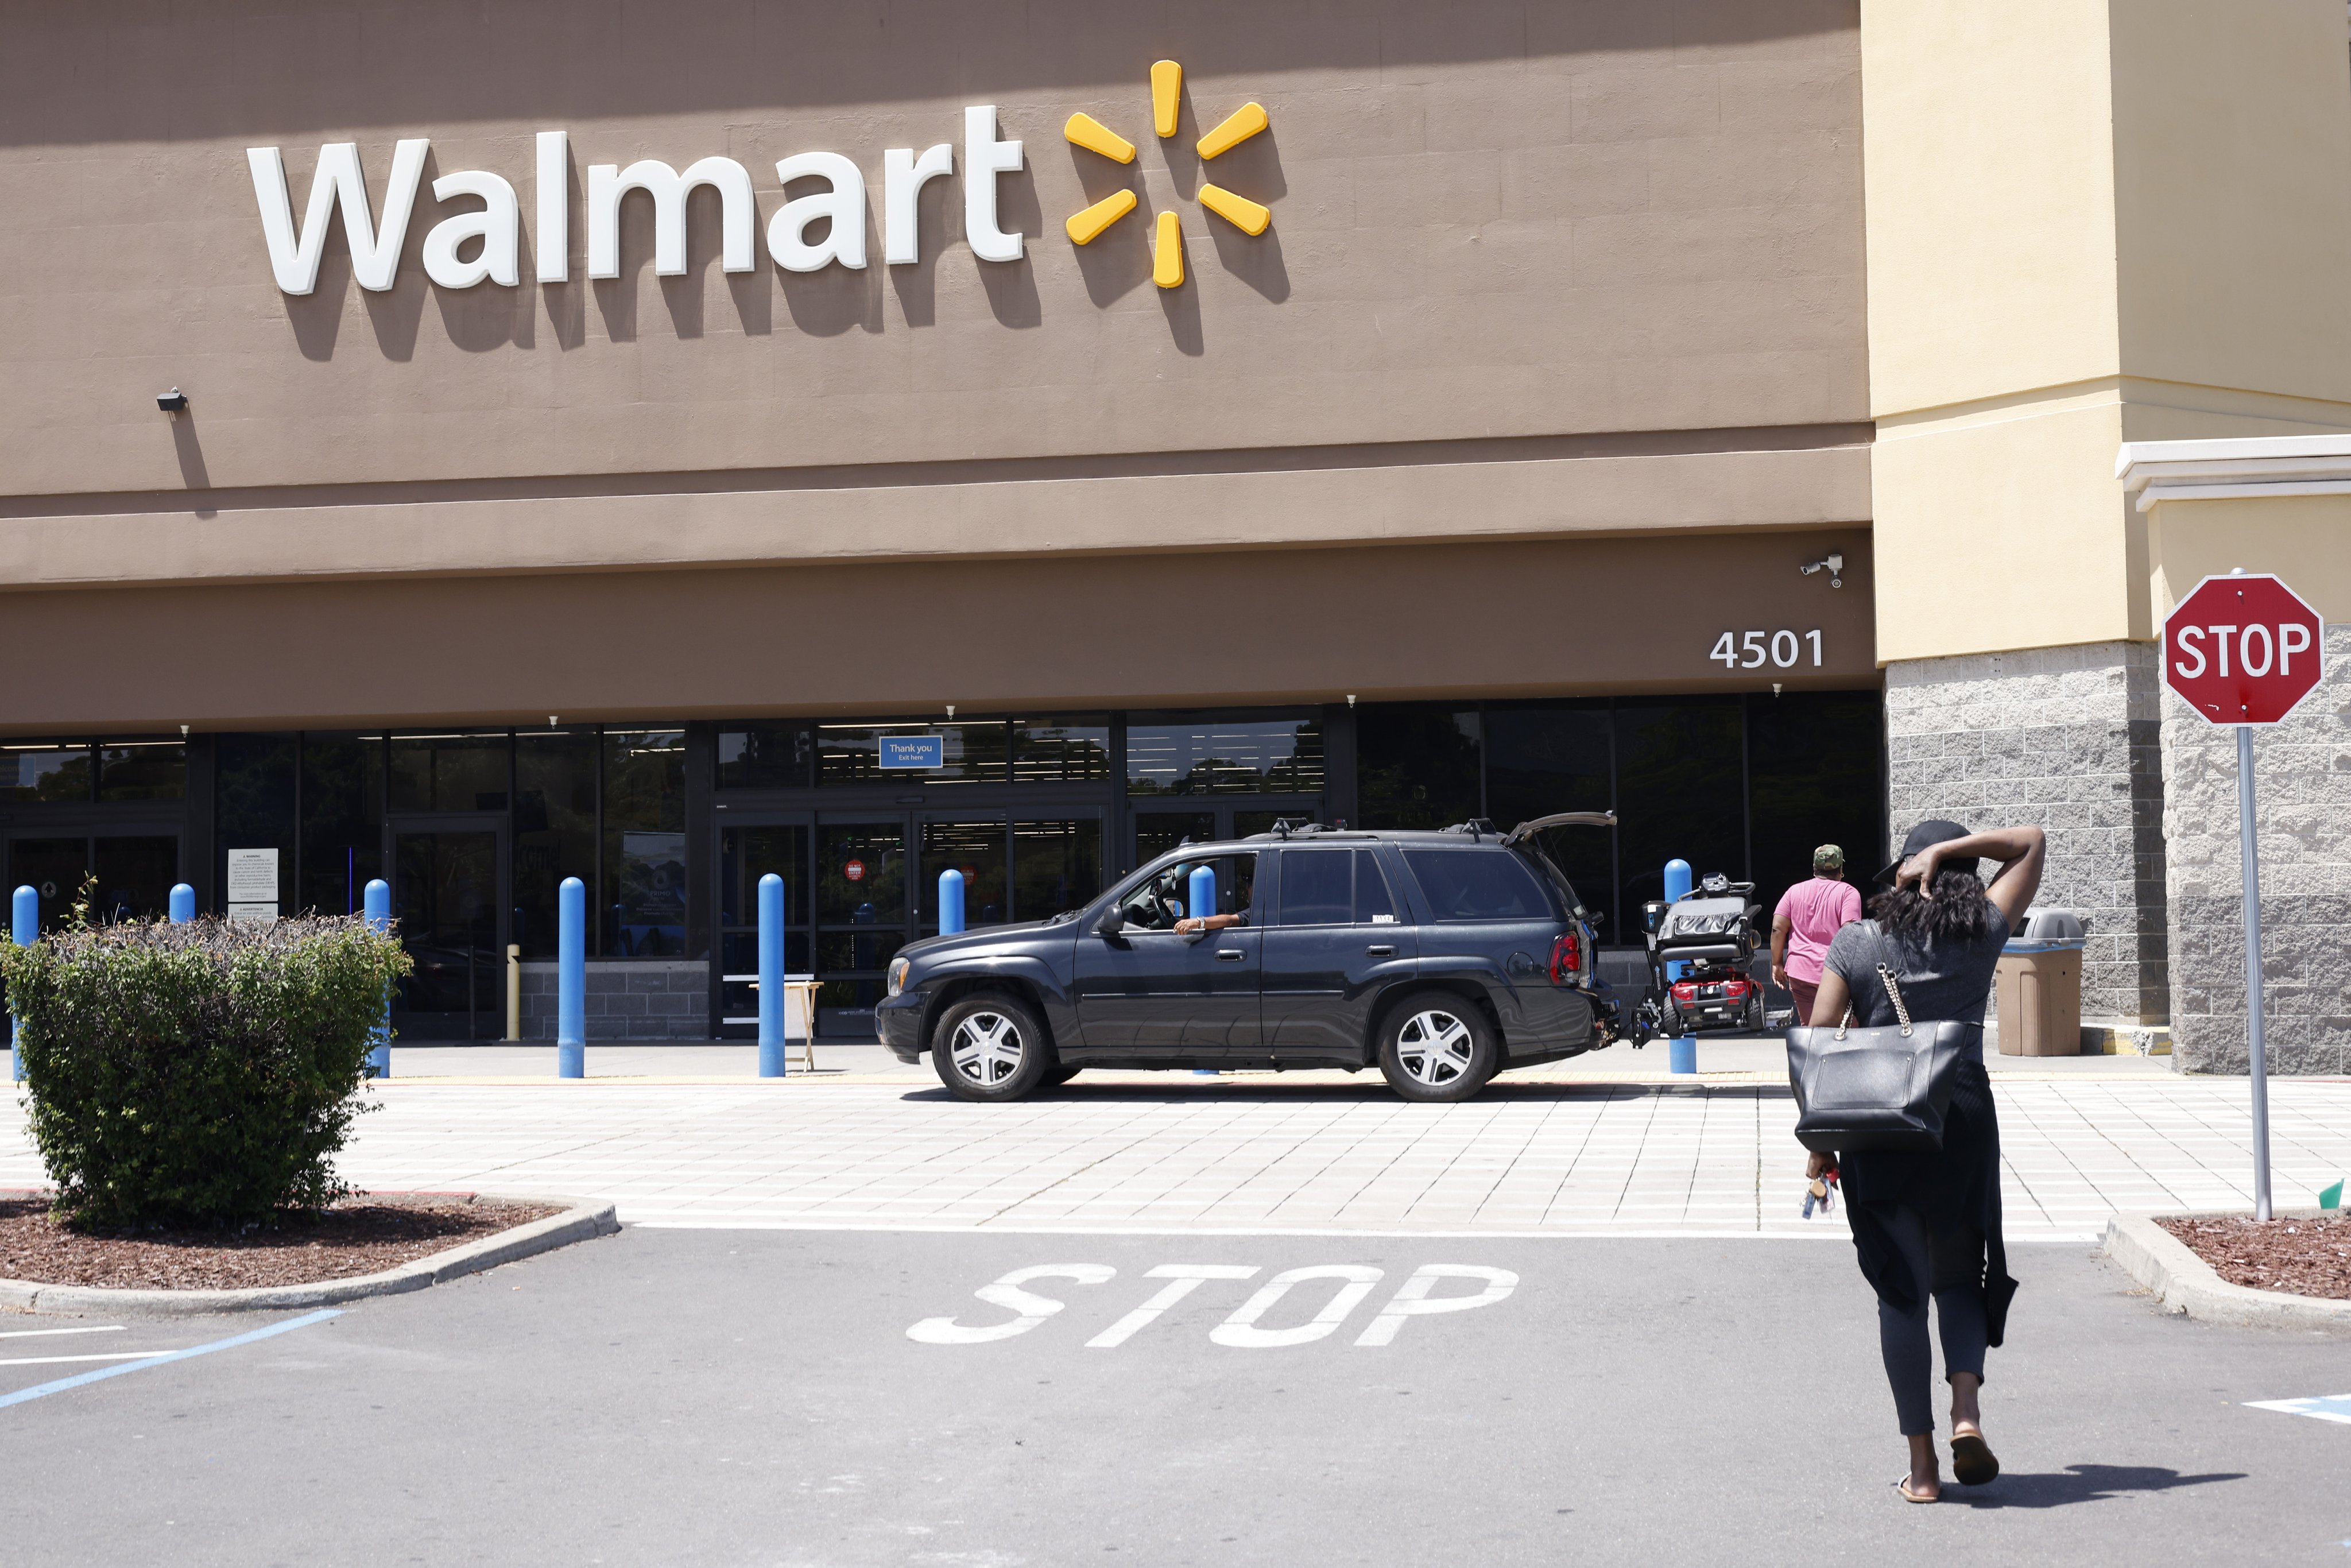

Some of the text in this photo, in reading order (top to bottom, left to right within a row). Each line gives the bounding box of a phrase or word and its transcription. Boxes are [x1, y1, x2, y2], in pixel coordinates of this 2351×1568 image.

[246, 105, 1024, 296] Walmart
[1709, 629, 1822, 669] 4501
[2175, 624, 2311, 679] STOP
[889, 744, 932, 754] Thank you
[906, 1263, 1520, 1348] STOP
